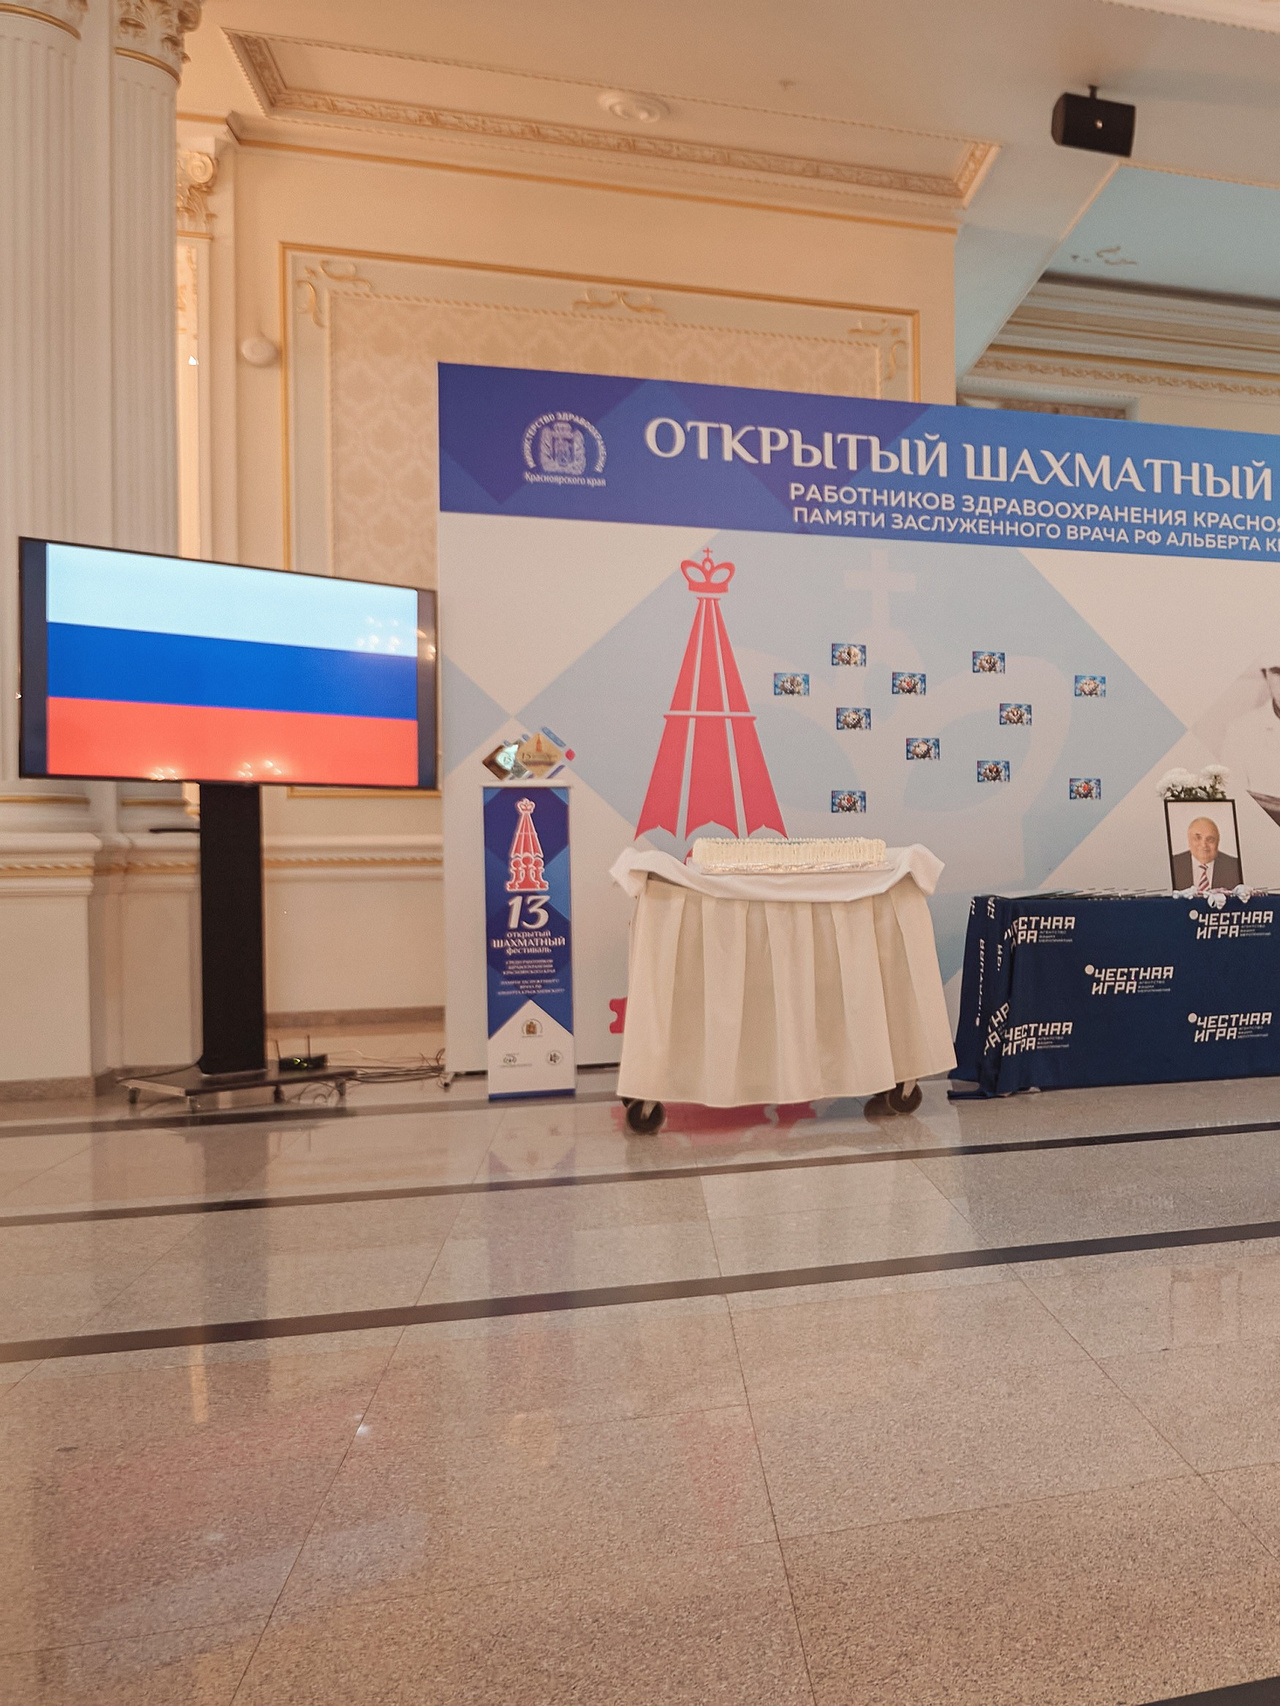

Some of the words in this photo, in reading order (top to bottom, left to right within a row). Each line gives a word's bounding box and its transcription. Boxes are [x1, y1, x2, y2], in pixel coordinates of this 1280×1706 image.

[645, 417, 948, 478] ОТКРЫТЫЙ
[963, 443, 1272, 501] ШАХМАТНЫЙ
[525, 472, 586, 486] Красноярского
[586, 478, 606, 487] края
[790, 482, 956, 511] РАБОТНИКОВ
[962, 495, 1187, 526] ЗДРАВООХРАНЕНИЯ
[794, 507, 886, 528] ПАМЯТИ
[891, 513, 1062, 540] ЗАСЛУЖЕННОГО
[1066, 525, 1129, 544] ВРАЧА
[1135, 529, 1162, 546] РФ
[1166, 531, 1261, 552] АЛЬБЕРТА
[508, 895, 551, 929] 13
[1198, 911, 1274, 926] ЧЕСТНАЯ
[1196, 925, 1239, 939] ИГРА
[492, 936, 566, 948] ШАХМАТНЫЙ
[1094, 966, 1174, 981] ЧЕСТНАЯ
[1091, 981, 1137, 995] ИГРА
[1196, 1012, 1272, 1029] ЧЕСТНАЯ
[1003, 1022, 1073, 1042] ЧЕСТНАЯ
[1194, 1027, 1237, 1043] ИГРА
